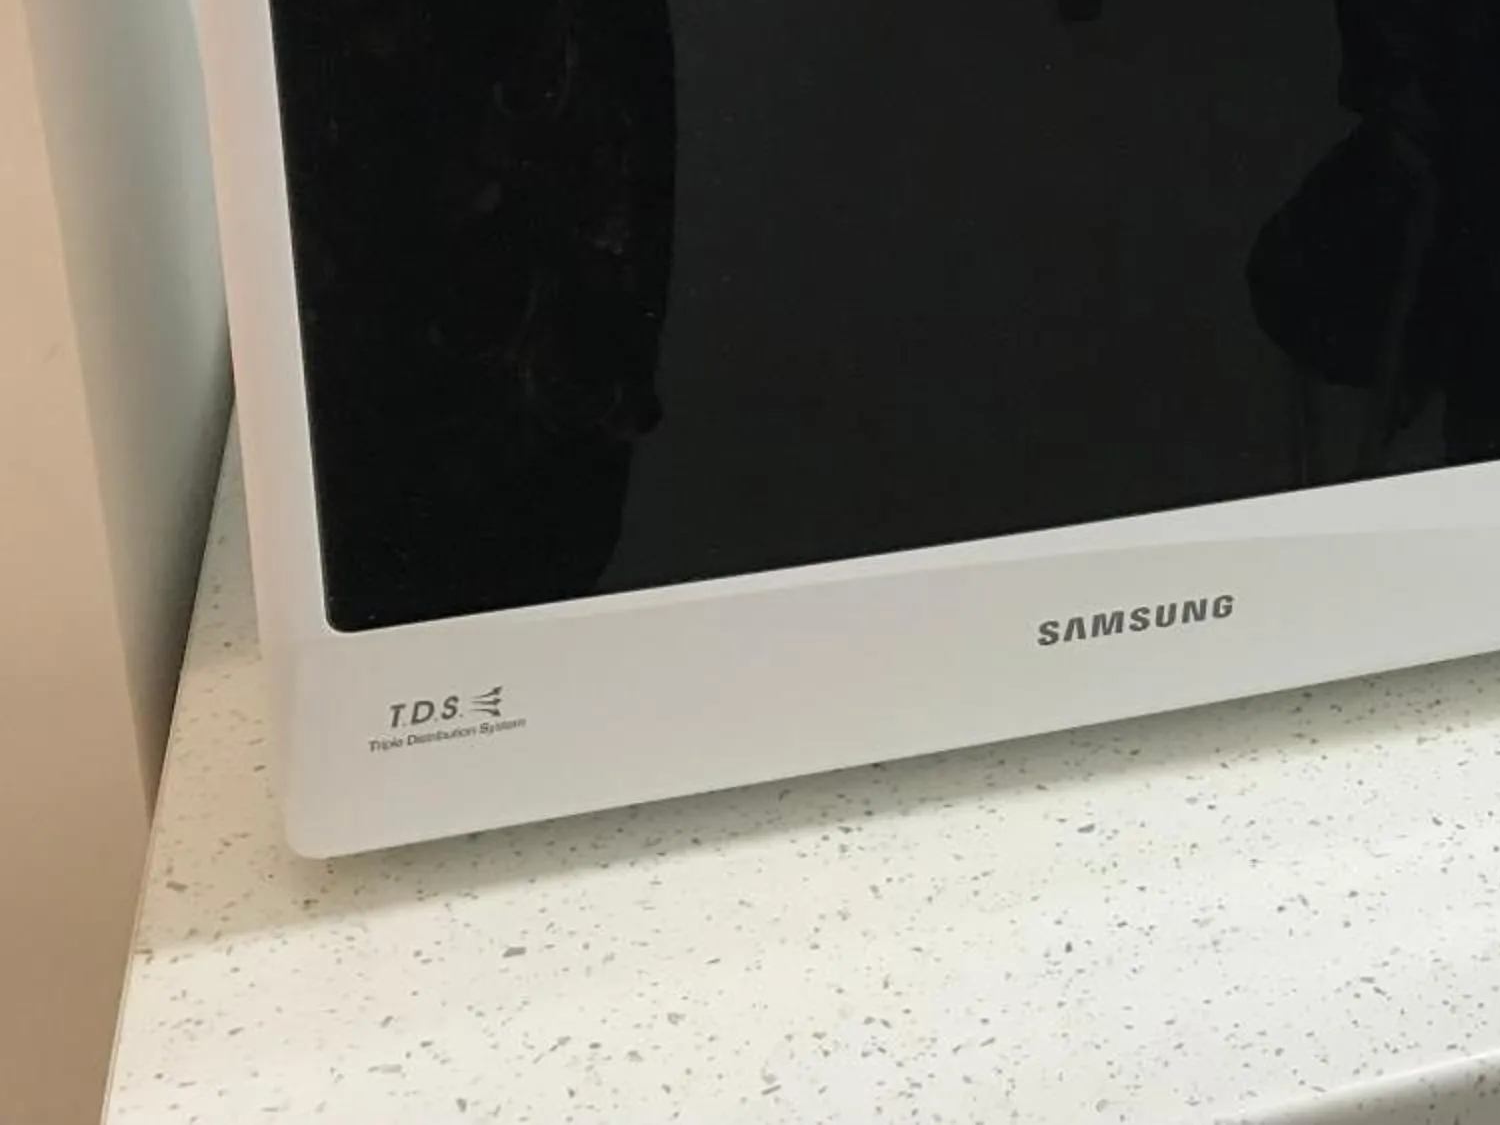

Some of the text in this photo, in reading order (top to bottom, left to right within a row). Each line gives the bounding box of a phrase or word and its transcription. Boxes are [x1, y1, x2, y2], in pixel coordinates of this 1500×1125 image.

[1037, 594, 1235, 647] SAMSUNG
[368, 718, 527, 753] Triple Distribution System
